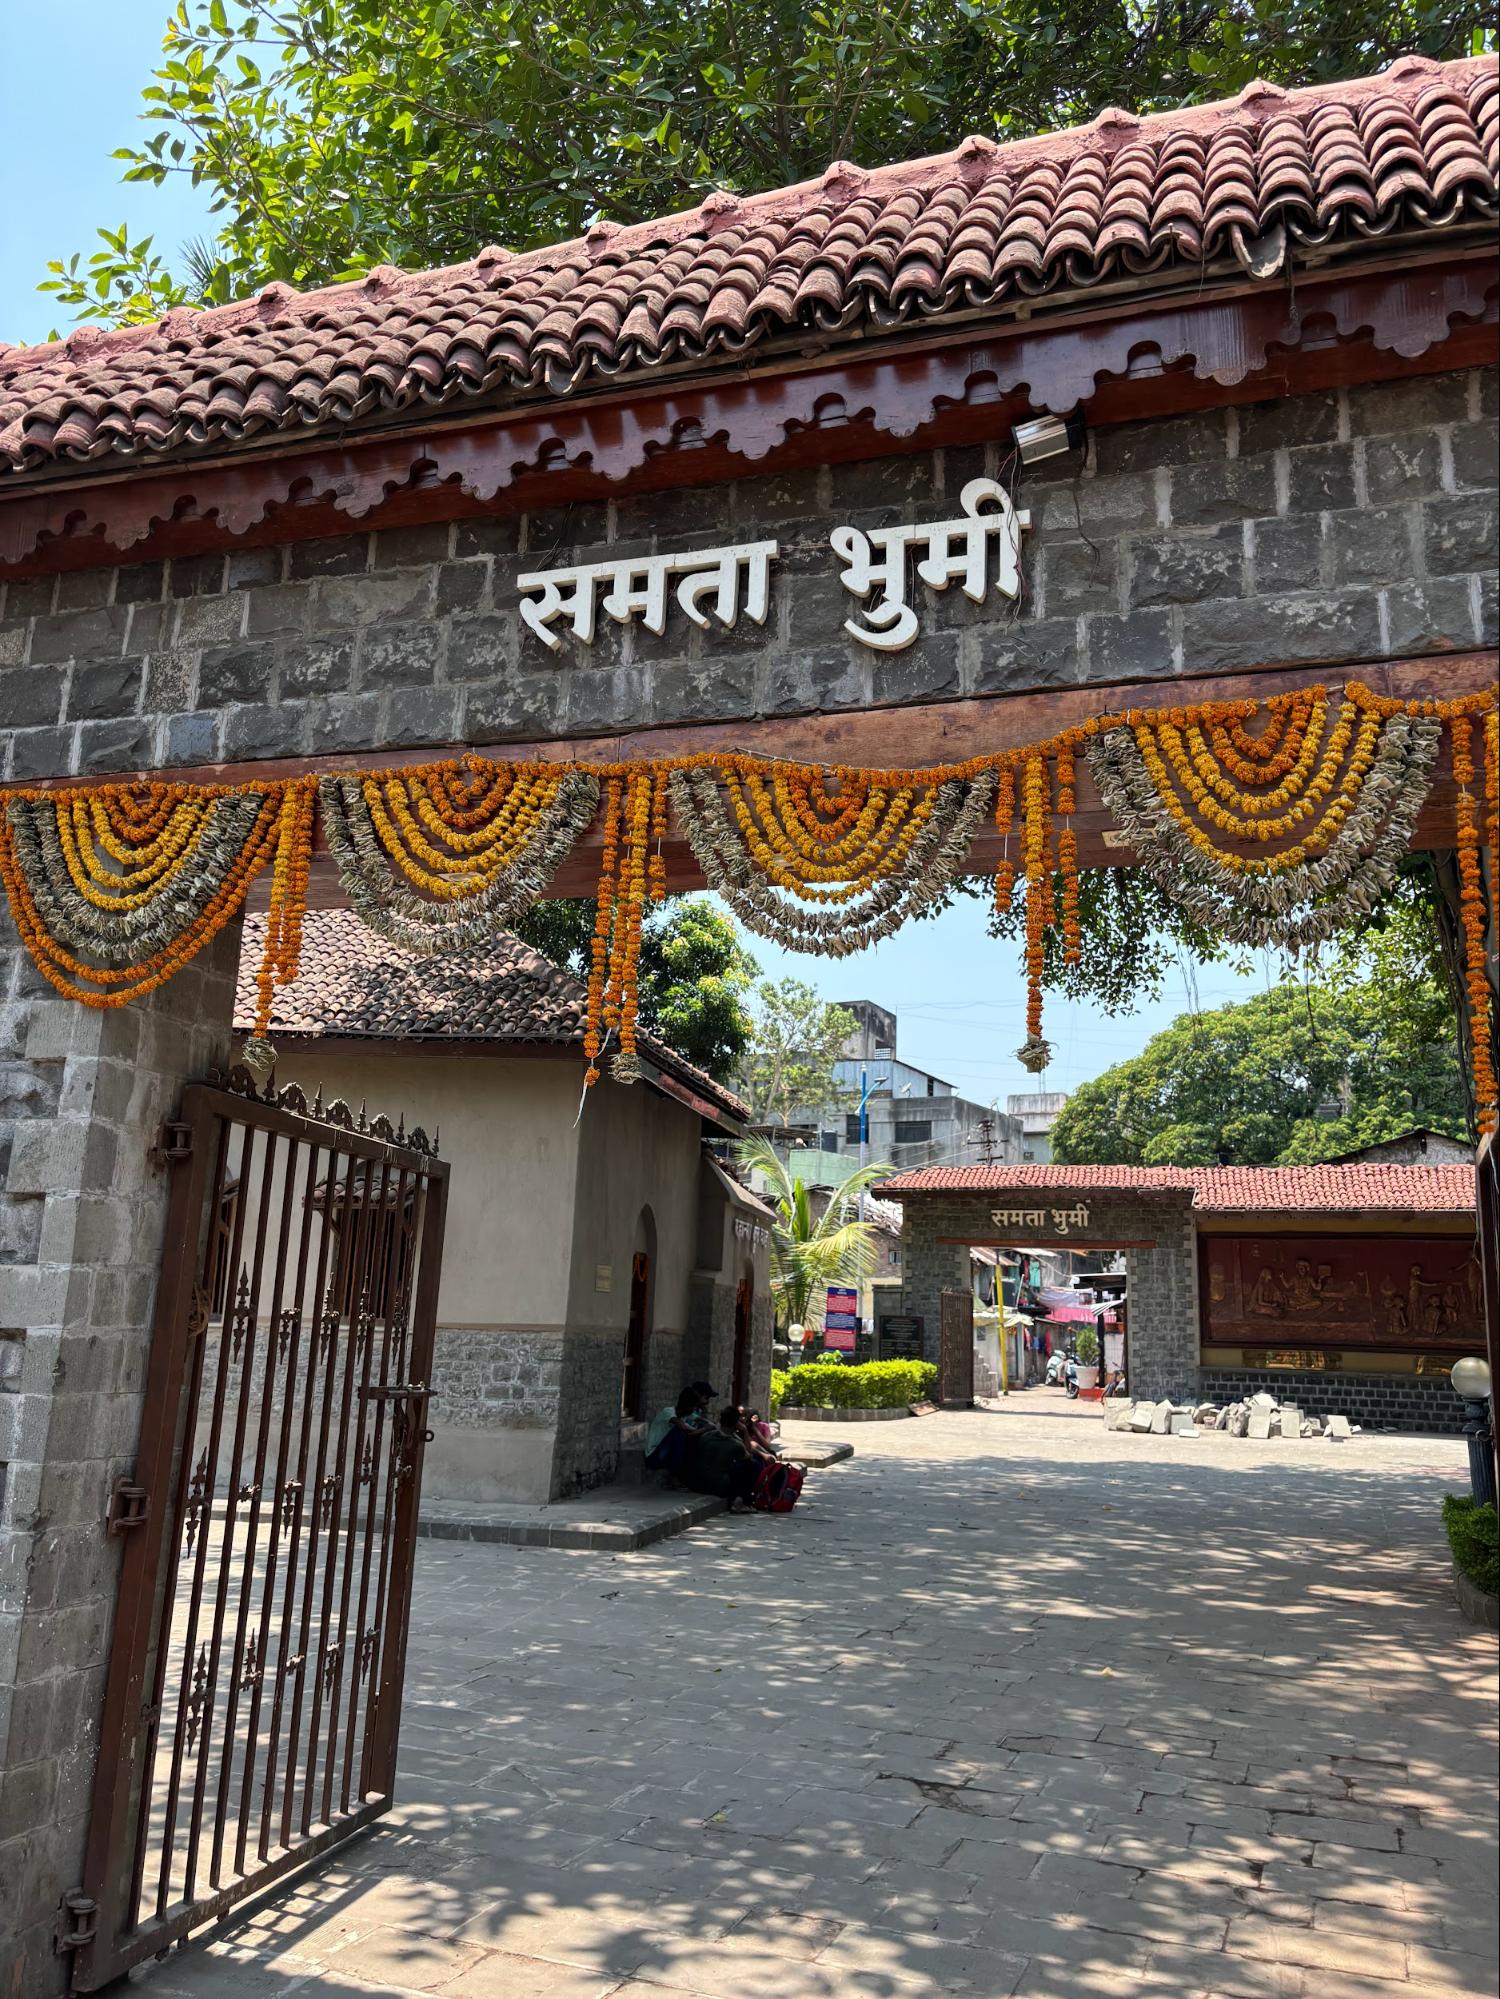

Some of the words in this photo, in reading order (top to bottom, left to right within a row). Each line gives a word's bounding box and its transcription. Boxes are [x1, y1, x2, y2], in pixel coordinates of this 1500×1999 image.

[517, 539, 779, 650] समता
[830, 478, 1031, 652] भुमी
[991, 1209, 1046, 1227] समता
[1051, 1203, 1090, 1235] भुमी
